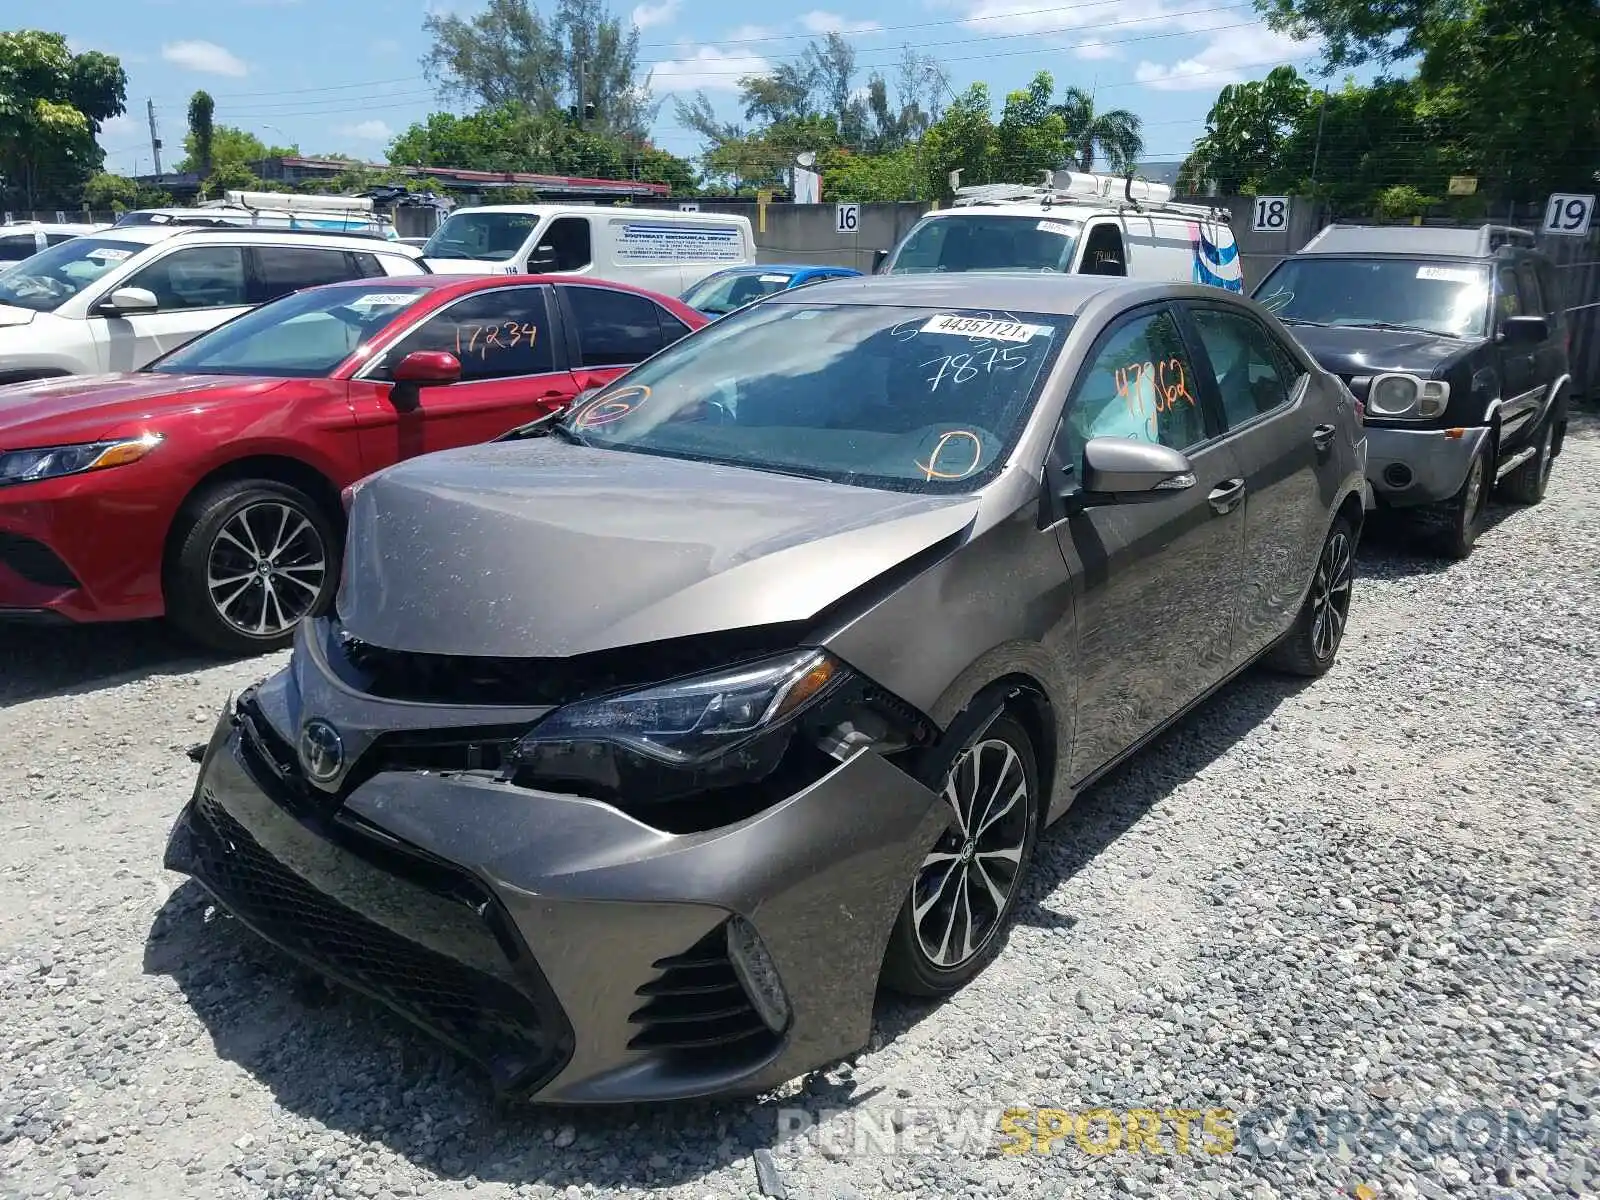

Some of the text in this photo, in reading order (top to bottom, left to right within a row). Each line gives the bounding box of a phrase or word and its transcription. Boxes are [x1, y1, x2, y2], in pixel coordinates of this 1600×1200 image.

[839, 206, 857, 229] 16
[1257, 199, 1285, 228] 18
[1551, 198, 1588, 230] 19
[919, 343, 1033, 392] 7875
